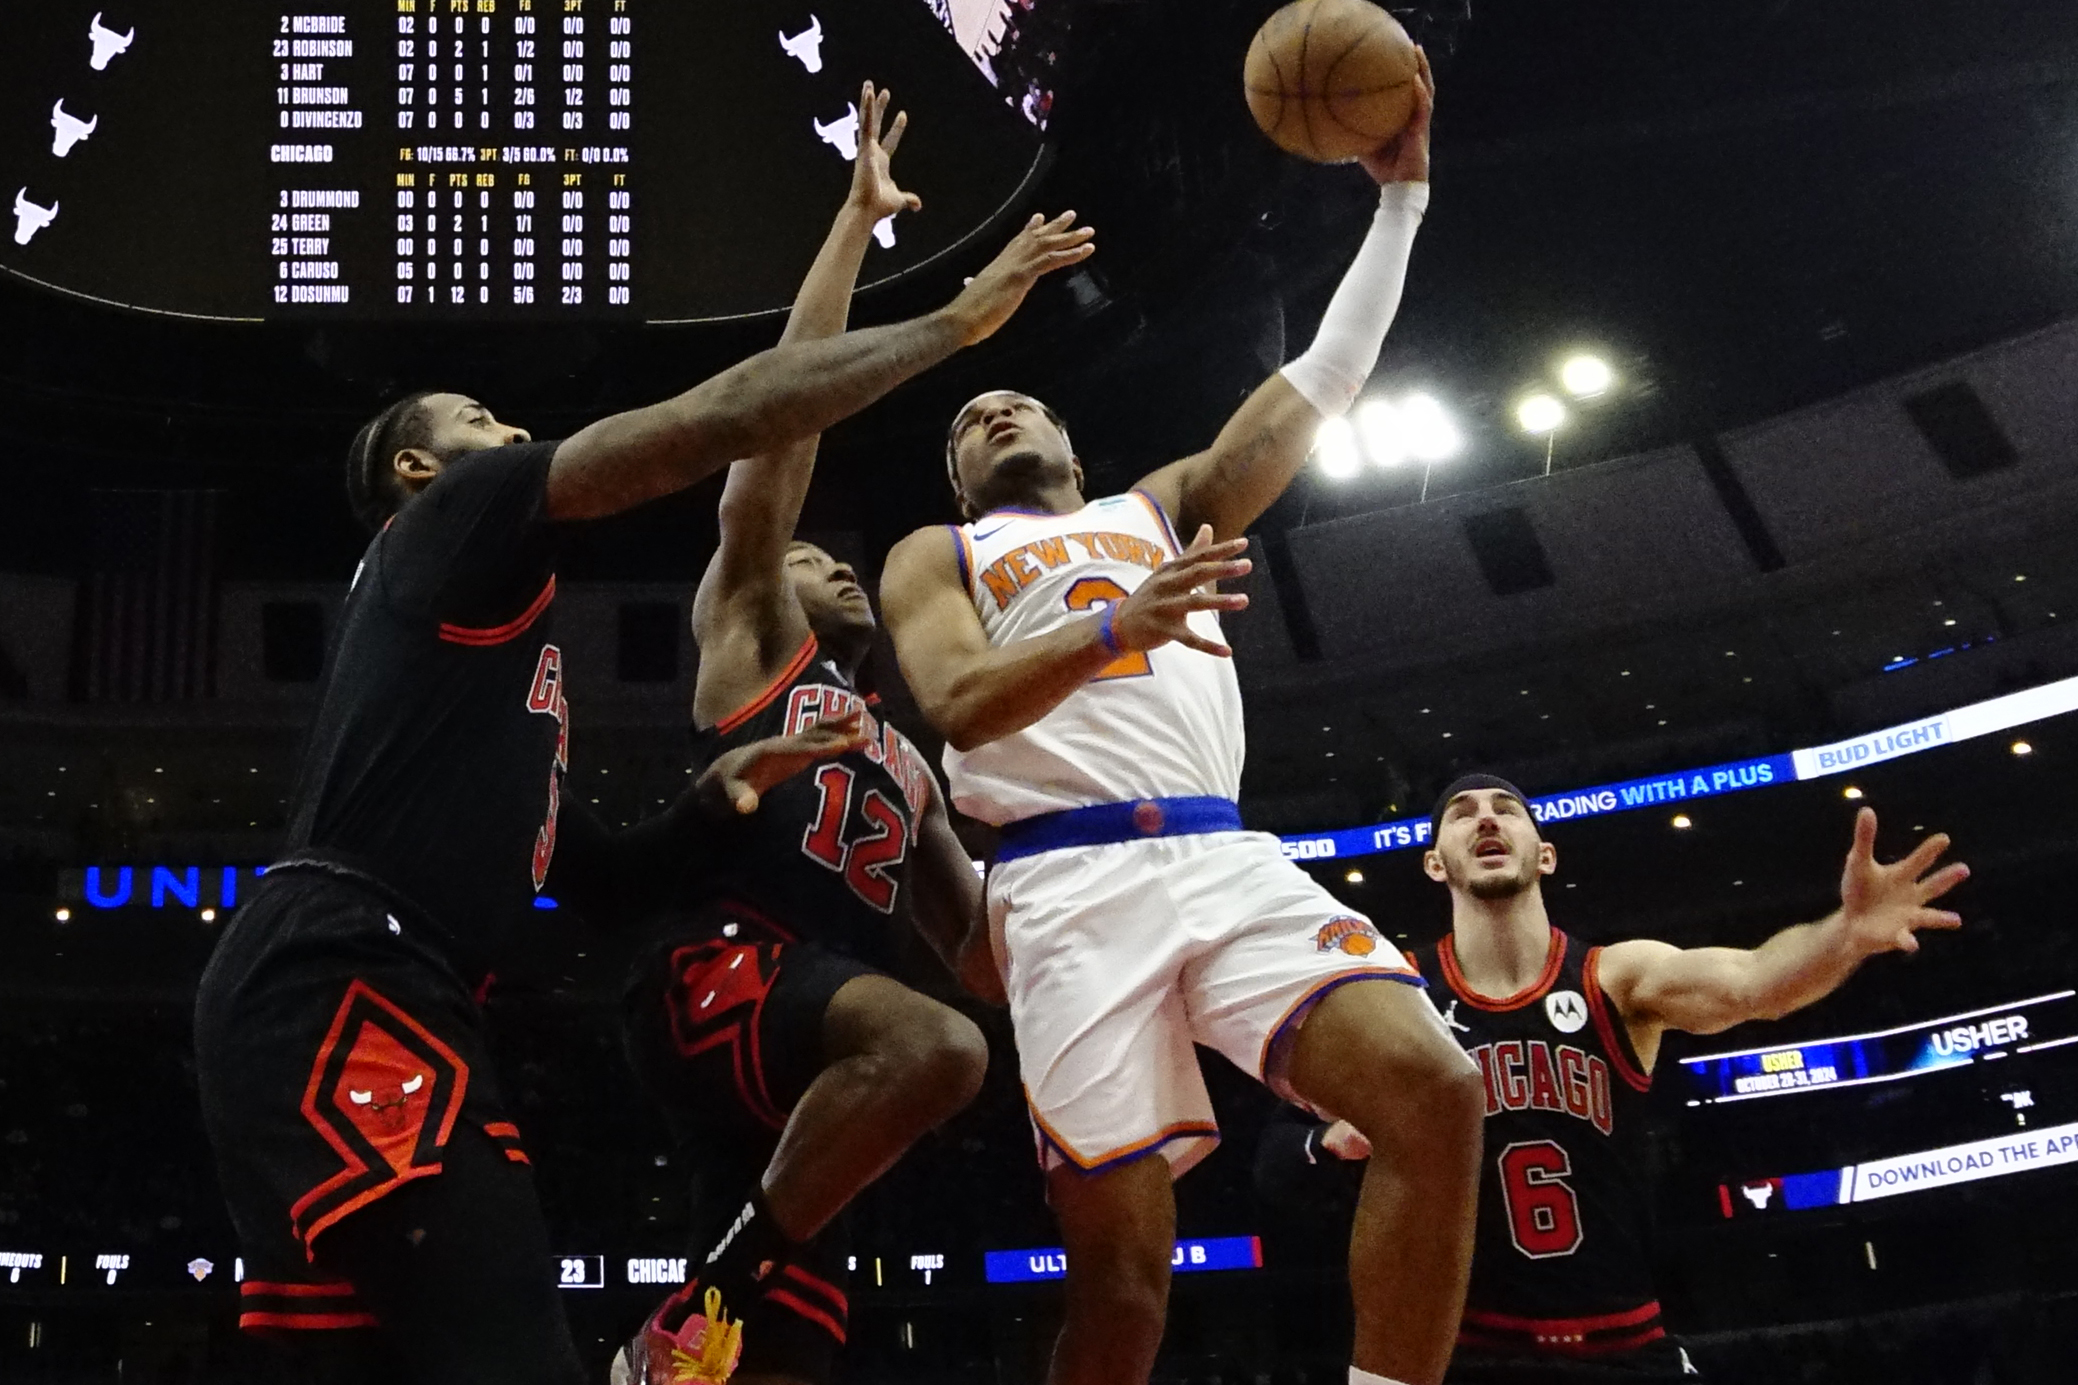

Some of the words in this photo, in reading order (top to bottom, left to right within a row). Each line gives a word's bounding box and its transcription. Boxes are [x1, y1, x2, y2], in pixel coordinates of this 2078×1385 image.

[397, 0, 416, 13] MIN
[429, 0, 436, 13] F
[450, 0, 469, 13] PTS
[476, 0, 496, 13] REB
[519, 0, 532, 12] FG
[564, 0, 583, 12] 3PT
[614, 0, 627, 12] FT
[280, 15, 290, 34] 2
[292, 15, 346, 34] MCBRIDE
[398, 15, 415, 34] 02
[428, 16, 438, 34] 0
[454, 16, 464, 34] 0
[481, 16, 490, 34] 0
[514, 15, 536, 35] 0/0
[563, 16, 584, 35] 0/0
[609, 16, 631, 35] 0/0
[272, 39, 290, 57] 23
[292, 39, 353, 58] ROBINSON
[398, 39, 415, 58] 02
[428, 39, 438, 58] 0
[454, 39, 464, 58] 2
[481, 40, 489, 58] 1
[516, 39, 535, 59] 1/2
[562, 39, 584, 59] 0/0
[609, 40, 631, 59] 0/0
[280, 63, 290, 81] 3
[292, 63, 324, 81] HART
[398, 63, 415, 82] 07
[428, 63, 437, 82] 0
[454, 63, 464, 82] 0
[481, 64, 488, 82] 1
[514, 63, 533, 83] 0/1
[562, 63, 584, 82] 0/0
[609, 63, 631, 83] 0/0
[276, 86, 289, 105] 11
[292, 86, 349, 105] BRUNSON
[398, 87, 414, 105] 07
[428, 87, 437, 105] 0
[454, 87, 463, 105] 5
[481, 87, 488, 105] 1
[513, 86, 535, 106] 2/6
[564, 87, 584, 106] 1/2
[609, 87, 631, 106] 0/0
[280, 110, 289, 128] 0
[291, 110, 363, 129] DIVINCENZO
[397, 110, 414, 129] 07
[427, 110, 437, 129] 0
[454, 111, 463, 129] 0
[480, 111, 490, 129] 0
[513, 110, 535, 130] 0/3
[562, 111, 583, 130] 0/3
[609, 111, 631, 130] 0/0
[270, 144, 333, 163] CHICAGO
[416, 145, 444, 164] 10/15
[502, 145, 522, 164] 3/5
[522, 146, 556, 163] 60.0%
[581, 146, 601, 165] 0/0
[602, 147, 629, 163] 0.0%
[396, 173, 415, 187] MIN
[429, 173, 436, 187] F
[449, 173, 468, 187] PTS
[476, 173, 495, 188] REB
[518, 173, 531, 186] FG
[563, 173, 582, 186] 3PT
[613, 173, 626, 187] FT
[279, 189, 289, 208] 3
[291, 189, 360, 209] DRUMMOND
[397, 190, 414, 209] 00
[427, 190, 437, 209] 0
[453, 190, 463, 209] 0
[480, 190, 489, 209] 0
[513, 190, 535, 209] 0/0
[562, 190, 584, 210] 0/0
[608, 190, 630, 210] 0/0
[271, 213, 289, 232] 24
[291, 213, 330, 232] GREEN
[397, 214, 414, 232] 03
[427, 214, 437, 232] 0
[453, 214, 463, 233] 2
[481, 214, 488, 232] 1
[515, 213, 532, 233] 1/1
[561, 214, 584, 233] 0/0
[608, 214, 631, 234] 0/0
[271, 237, 289, 256] 25
[291, 237, 330, 256] TERRY
[396, 237, 414, 256] 00
[427, 238, 437, 256] 0
[453, 238, 463, 256] 0
[479, 238, 489, 256] 0
[513, 237, 535, 257] 0/0
[561, 237, 583, 257] 0/0
[608, 238, 630, 257] 0/0
[279, 261, 289, 279] 6
[291, 261, 339, 280] CARUSO
[396, 261, 414, 280] 05
[427, 261, 436, 280] 0
[453, 261, 463, 280] 0
[479, 262, 489, 280] 0
[513, 261, 535, 281] 0/0
[561, 261, 583, 281] 0/0
[608, 262, 630, 281] 0/0
[273, 284, 288, 303] 12
[291, 284, 350, 304] DOSUNMU
[397, 285, 413, 304] 07
[427, 285, 435, 304] 1
[450, 285, 465, 304] 12
[479, 285, 489, 304] 0
[513, 285, 535, 304] 5/6
[561, 285, 583, 305] 2/3
[608, 285, 630, 305] 0/0
[979, 535, 1071, 612] NEW
[1818, 743, 1870, 770] BUD
[1875, 721, 1944, 754] LIGHT
[1374, 826, 1411, 849] IT'S
[1414, 822, 1432, 842] F
[1620, 779, 1686, 806] WITH
[1691, 775, 1708, 795] A
[1713, 764, 1774, 791] PLUS
[801, 761, 908, 914] 12
[86, 866, 267, 908] UNI
[1931, 1015, 2030, 1056] USHER
[1761, 1050, 1805, 1073] USHER
[1868, 1150, 1995, 1189] DOWNLOAD
[1998, 1141, 2040, 1164] THE
[1498, 1139, 1583, 1260] 6
[95, 1254, 130, 1270] FOULS
[561, 1258, 586, 1284] 23
[911, 1253, 944, 1271] FOULS
[924, 1269, 933, 1286] 1
